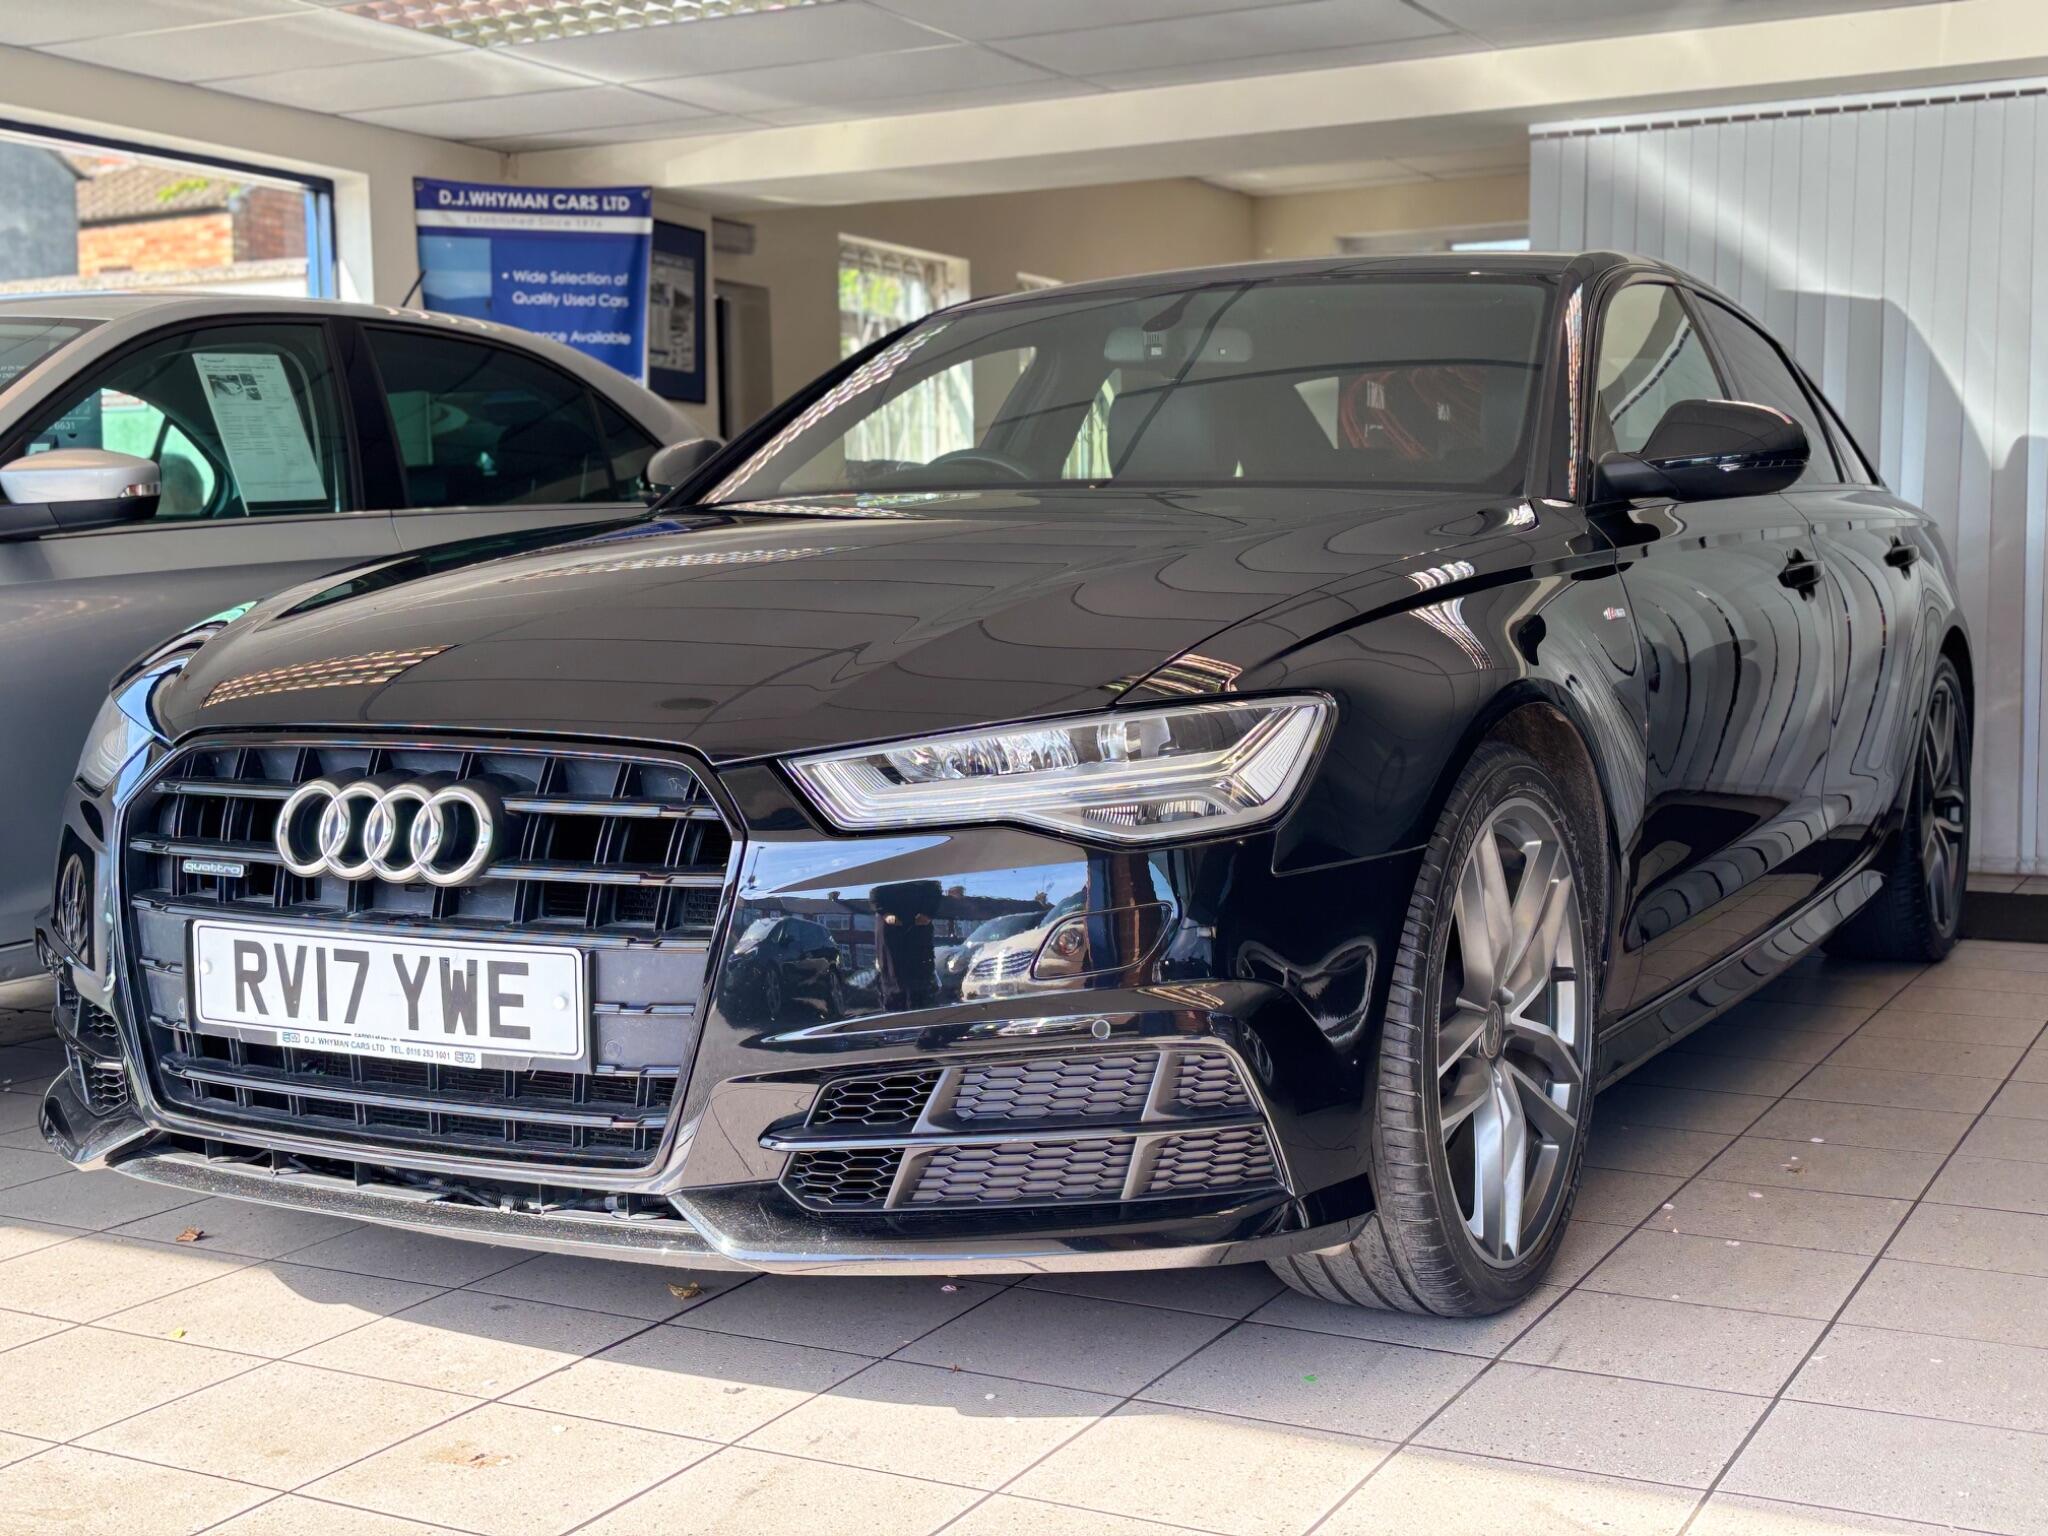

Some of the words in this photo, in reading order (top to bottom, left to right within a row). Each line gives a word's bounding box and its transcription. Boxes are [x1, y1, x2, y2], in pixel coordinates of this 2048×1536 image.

[438, 189, 550, 210] D.J.WHYMAN
[552, 193, 599, 212] CARS
[602, 195, 631, 212] LTD
[512, 270, 548, 284] Wide
[550, 271, 612, 286] Selection
[613, 273, 629, 287] of
[512, 290, 561, 308] Quality
[562, 292, 596, 307] Used
[598, 293, 630, 309] Cars
[569, 330, 632, 345] Available
[184, 862, 241, 874] quattro
[233, 938, 370, 1026] RV17
[392, 952, 532, 1041] YWE
[318, 1037, 349, 1048] WHYMAN
[350, 1040, 370, 1051] CARS
[371, 1043, 386, 1053] LTD
